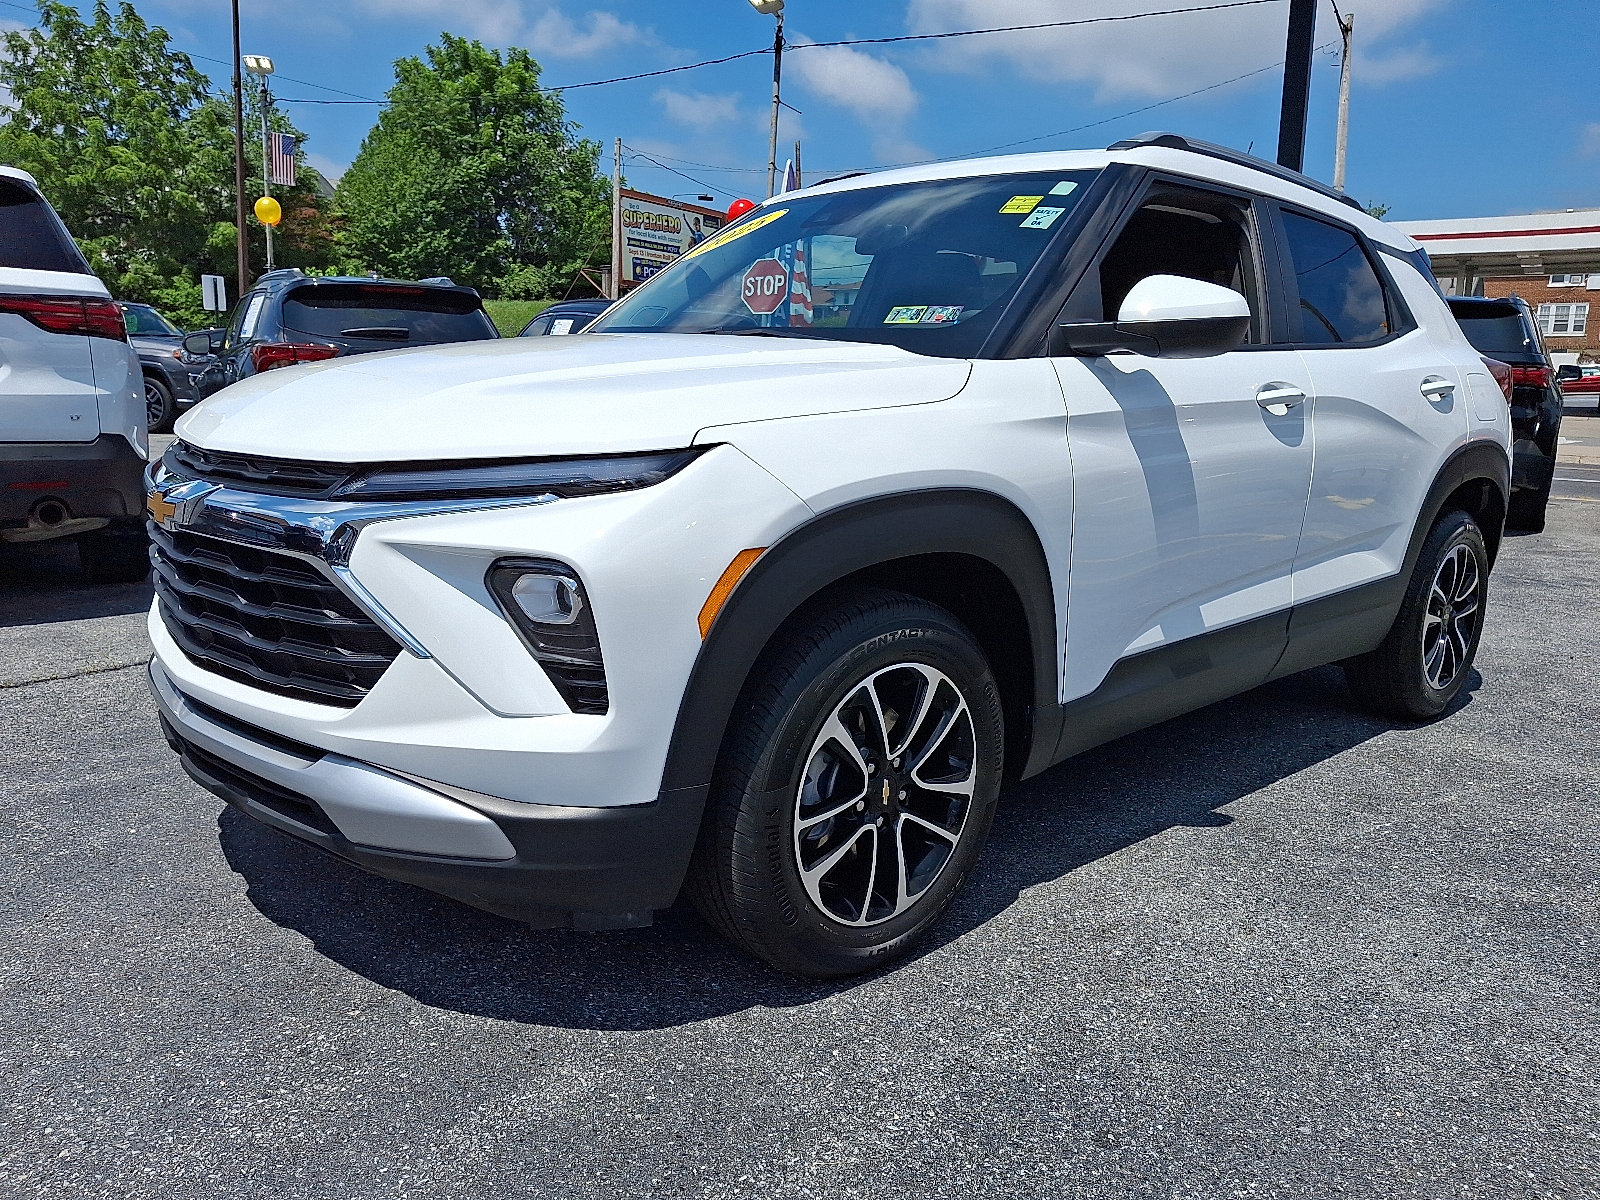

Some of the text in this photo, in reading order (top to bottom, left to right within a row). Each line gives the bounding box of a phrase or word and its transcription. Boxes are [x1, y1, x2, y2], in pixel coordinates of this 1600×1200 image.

[623, 209, 681, 234] SUPERHERO
[636, 229, 647, 238] local
[648, 230, 657, 239] kids
[657, 233, 667, 241] with
[744, 275, 785, 296] STOP
